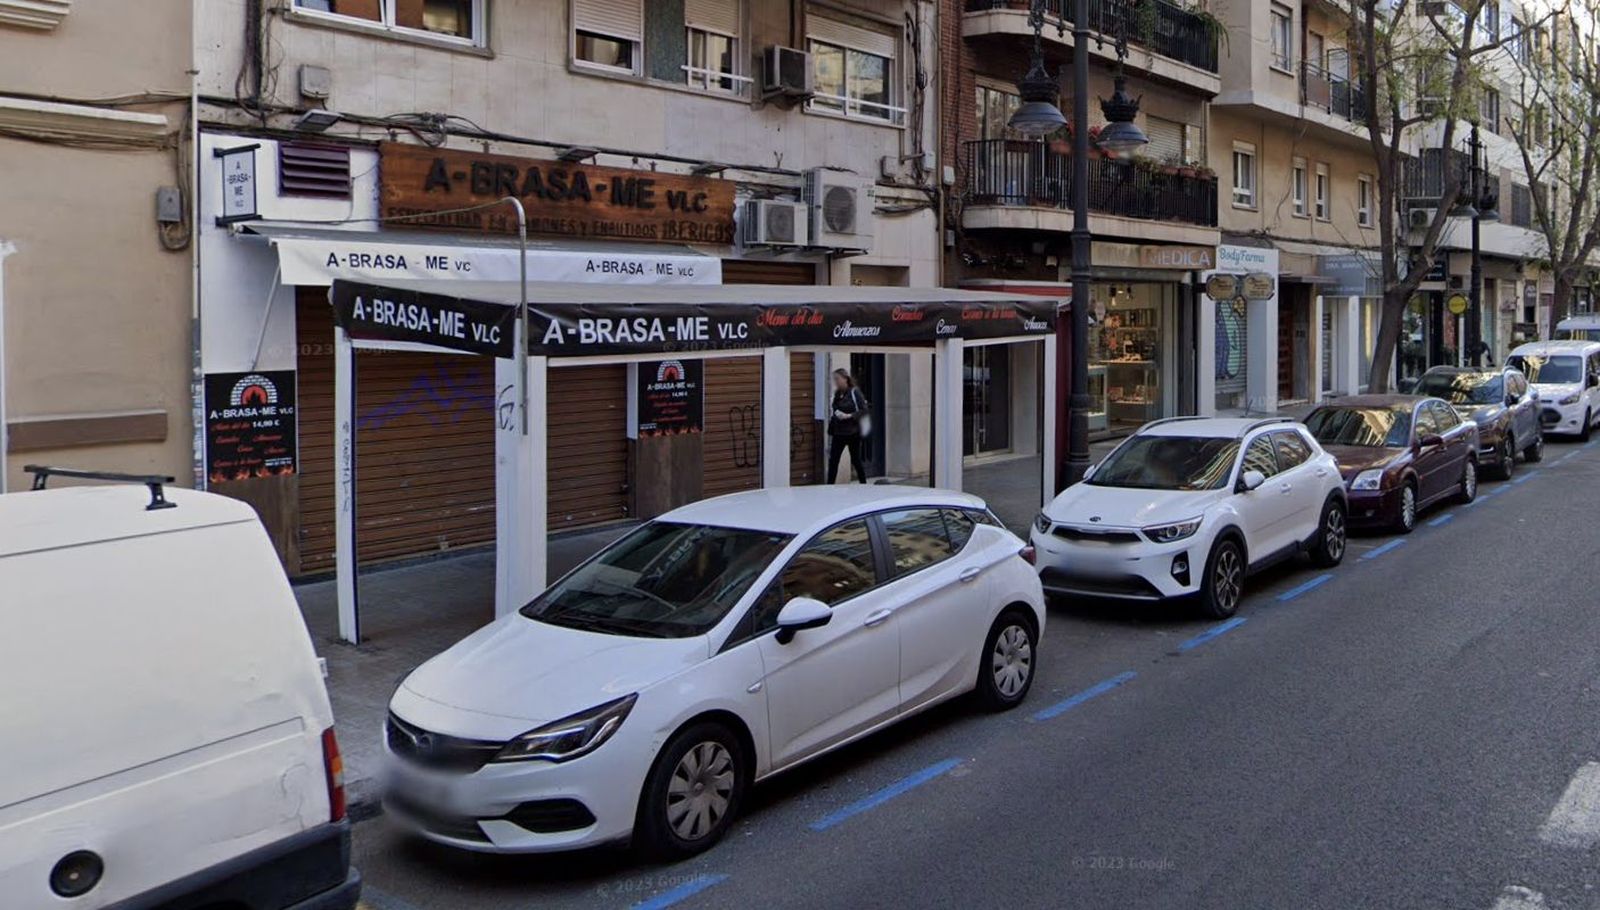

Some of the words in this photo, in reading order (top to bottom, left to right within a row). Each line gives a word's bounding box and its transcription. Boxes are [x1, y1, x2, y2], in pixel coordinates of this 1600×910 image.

[425, 157, 656, 210] A-BRASA-ME
[667, 189, 708, 214] VLC
[327, 252, 408, 270] A-BRASA
[425, 255, 449, 270] ME
[586, 259, 644, 275] A-BRASA
[656, 263, 674, 276] ME
[678, 267, 694, 278] VLC
[352, 295, 466, 340] A-BRASA-ME
[471, 322, 501, 345] VLC
[542, 316, 709, 345] A-BRASA-ME
[717, 321, 748, 340] VLC
[209, 406, 277, 419] A-BRASA-ME
